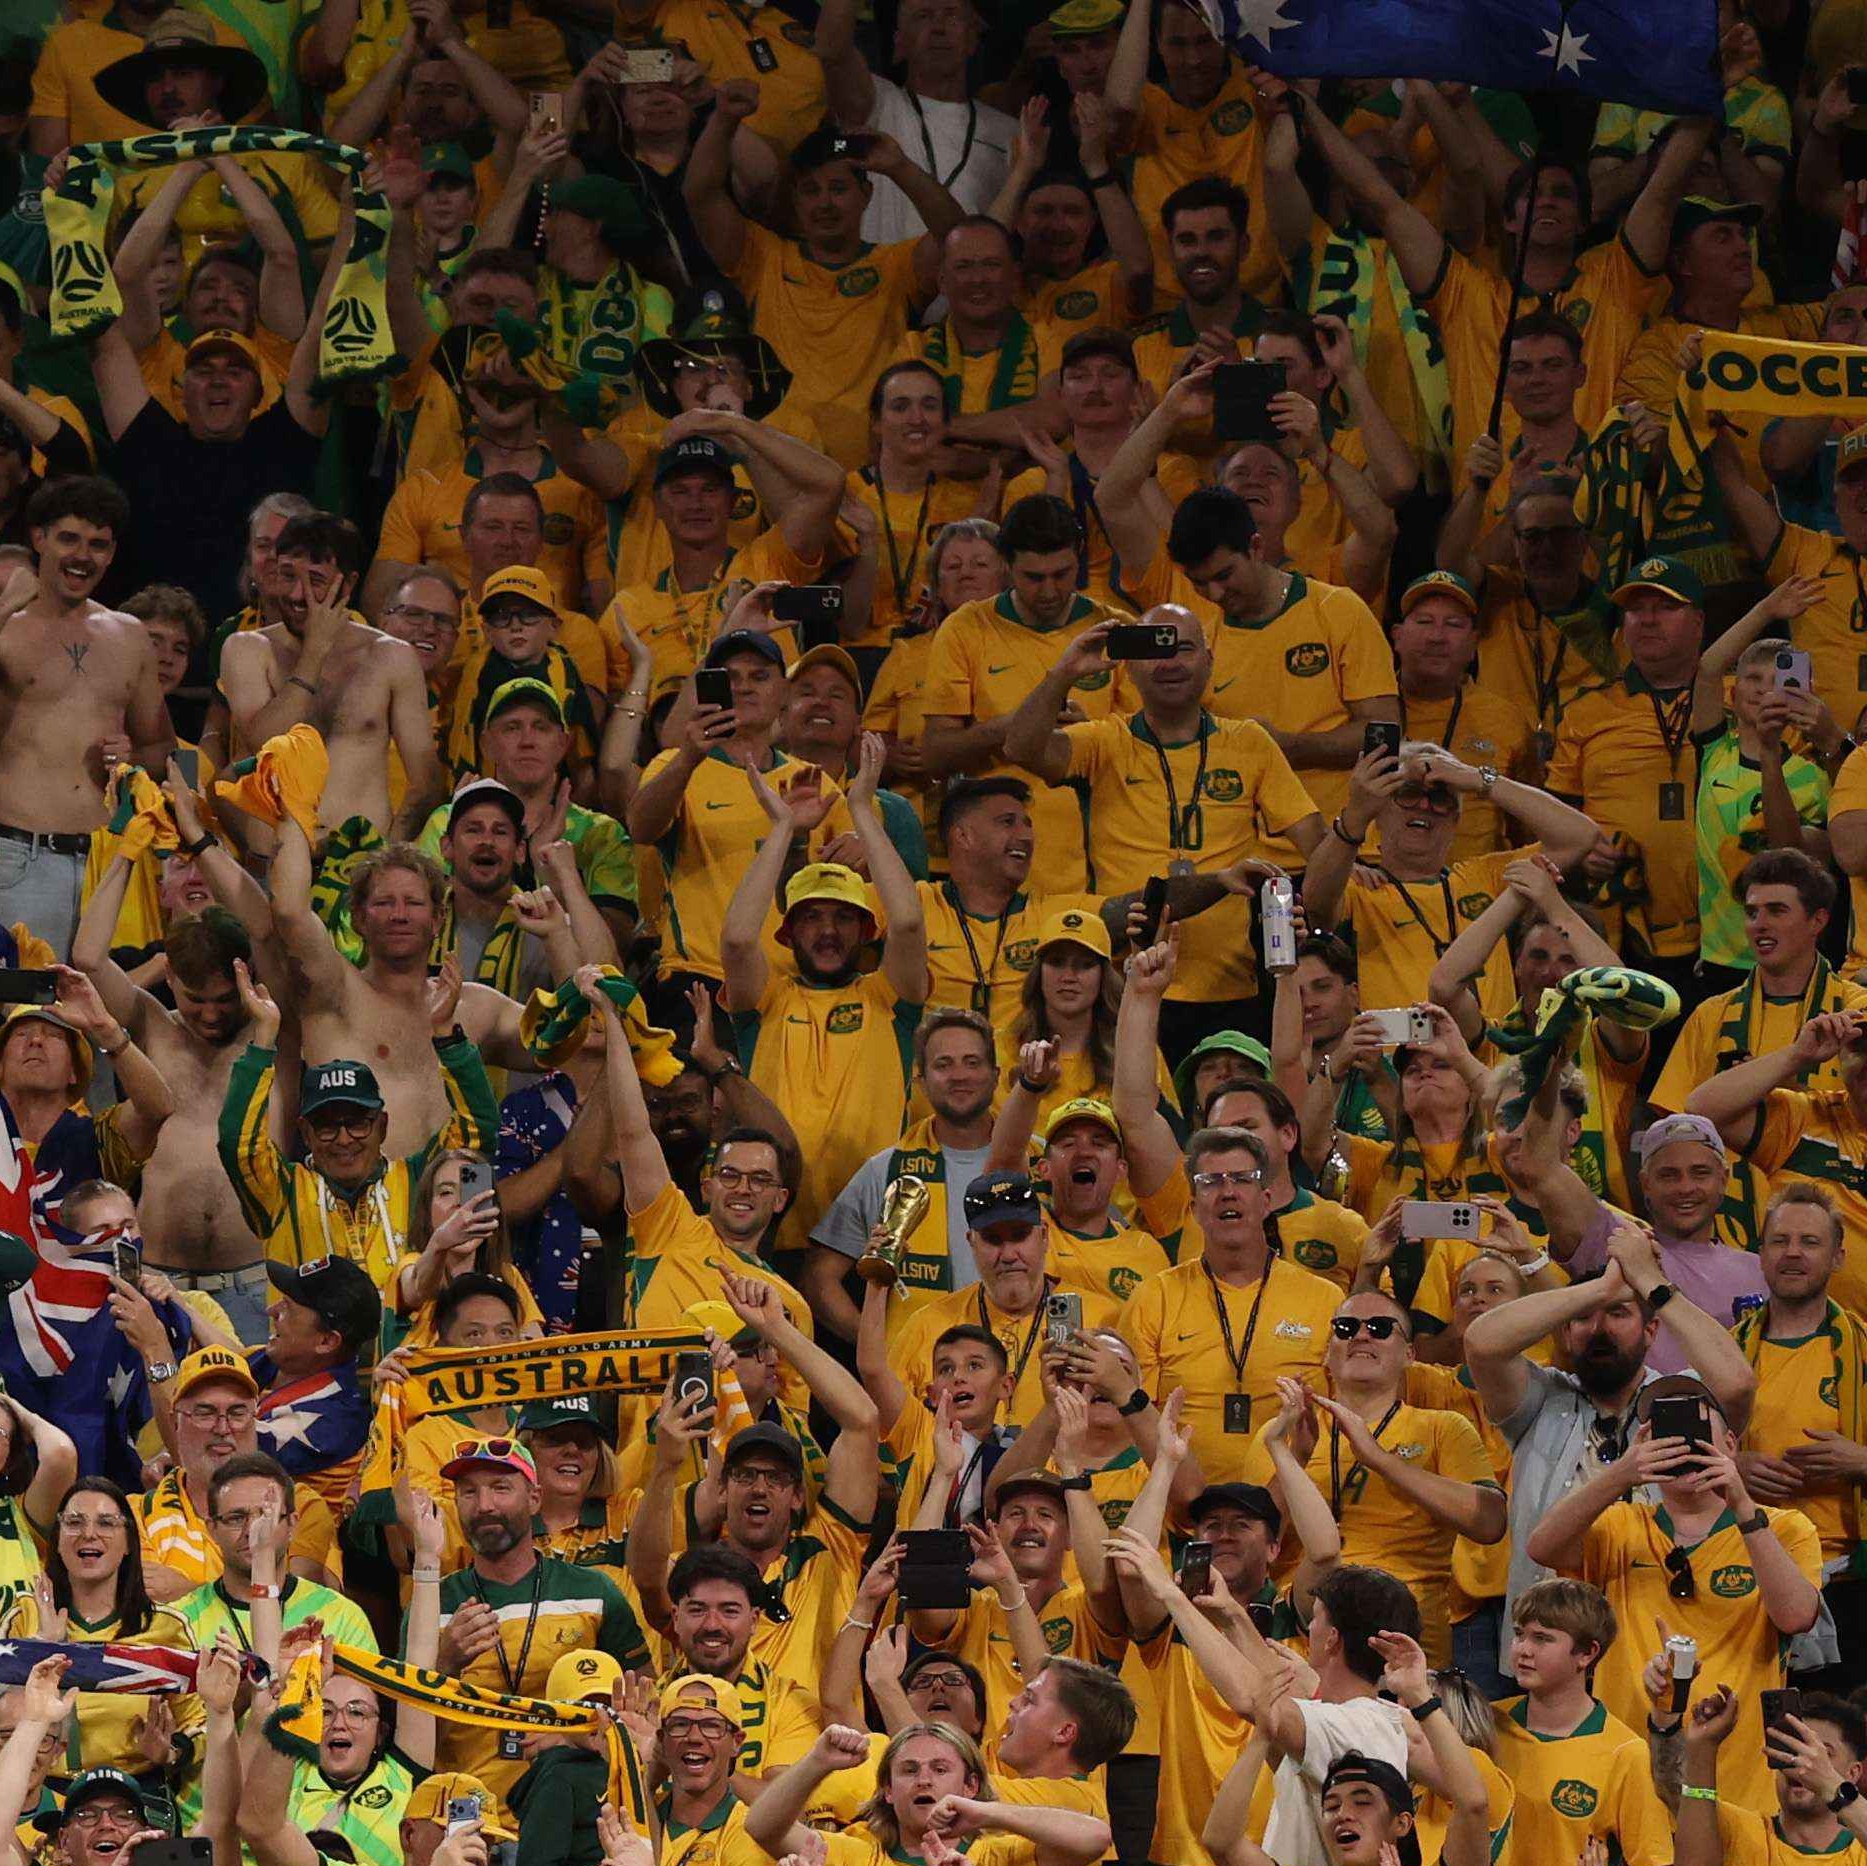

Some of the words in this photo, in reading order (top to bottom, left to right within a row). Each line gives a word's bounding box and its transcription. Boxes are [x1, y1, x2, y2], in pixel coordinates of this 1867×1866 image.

[676, 440, 716, 457] AUS
[318, 1067, 357, 1090] AUS
[557, 1344, 604, 1358] GOLD
[607, 1339, 653, 1350] ARMY
[199, 1352, 236, 1369] AUS
[551, 1396, 590, 1413] AUS
